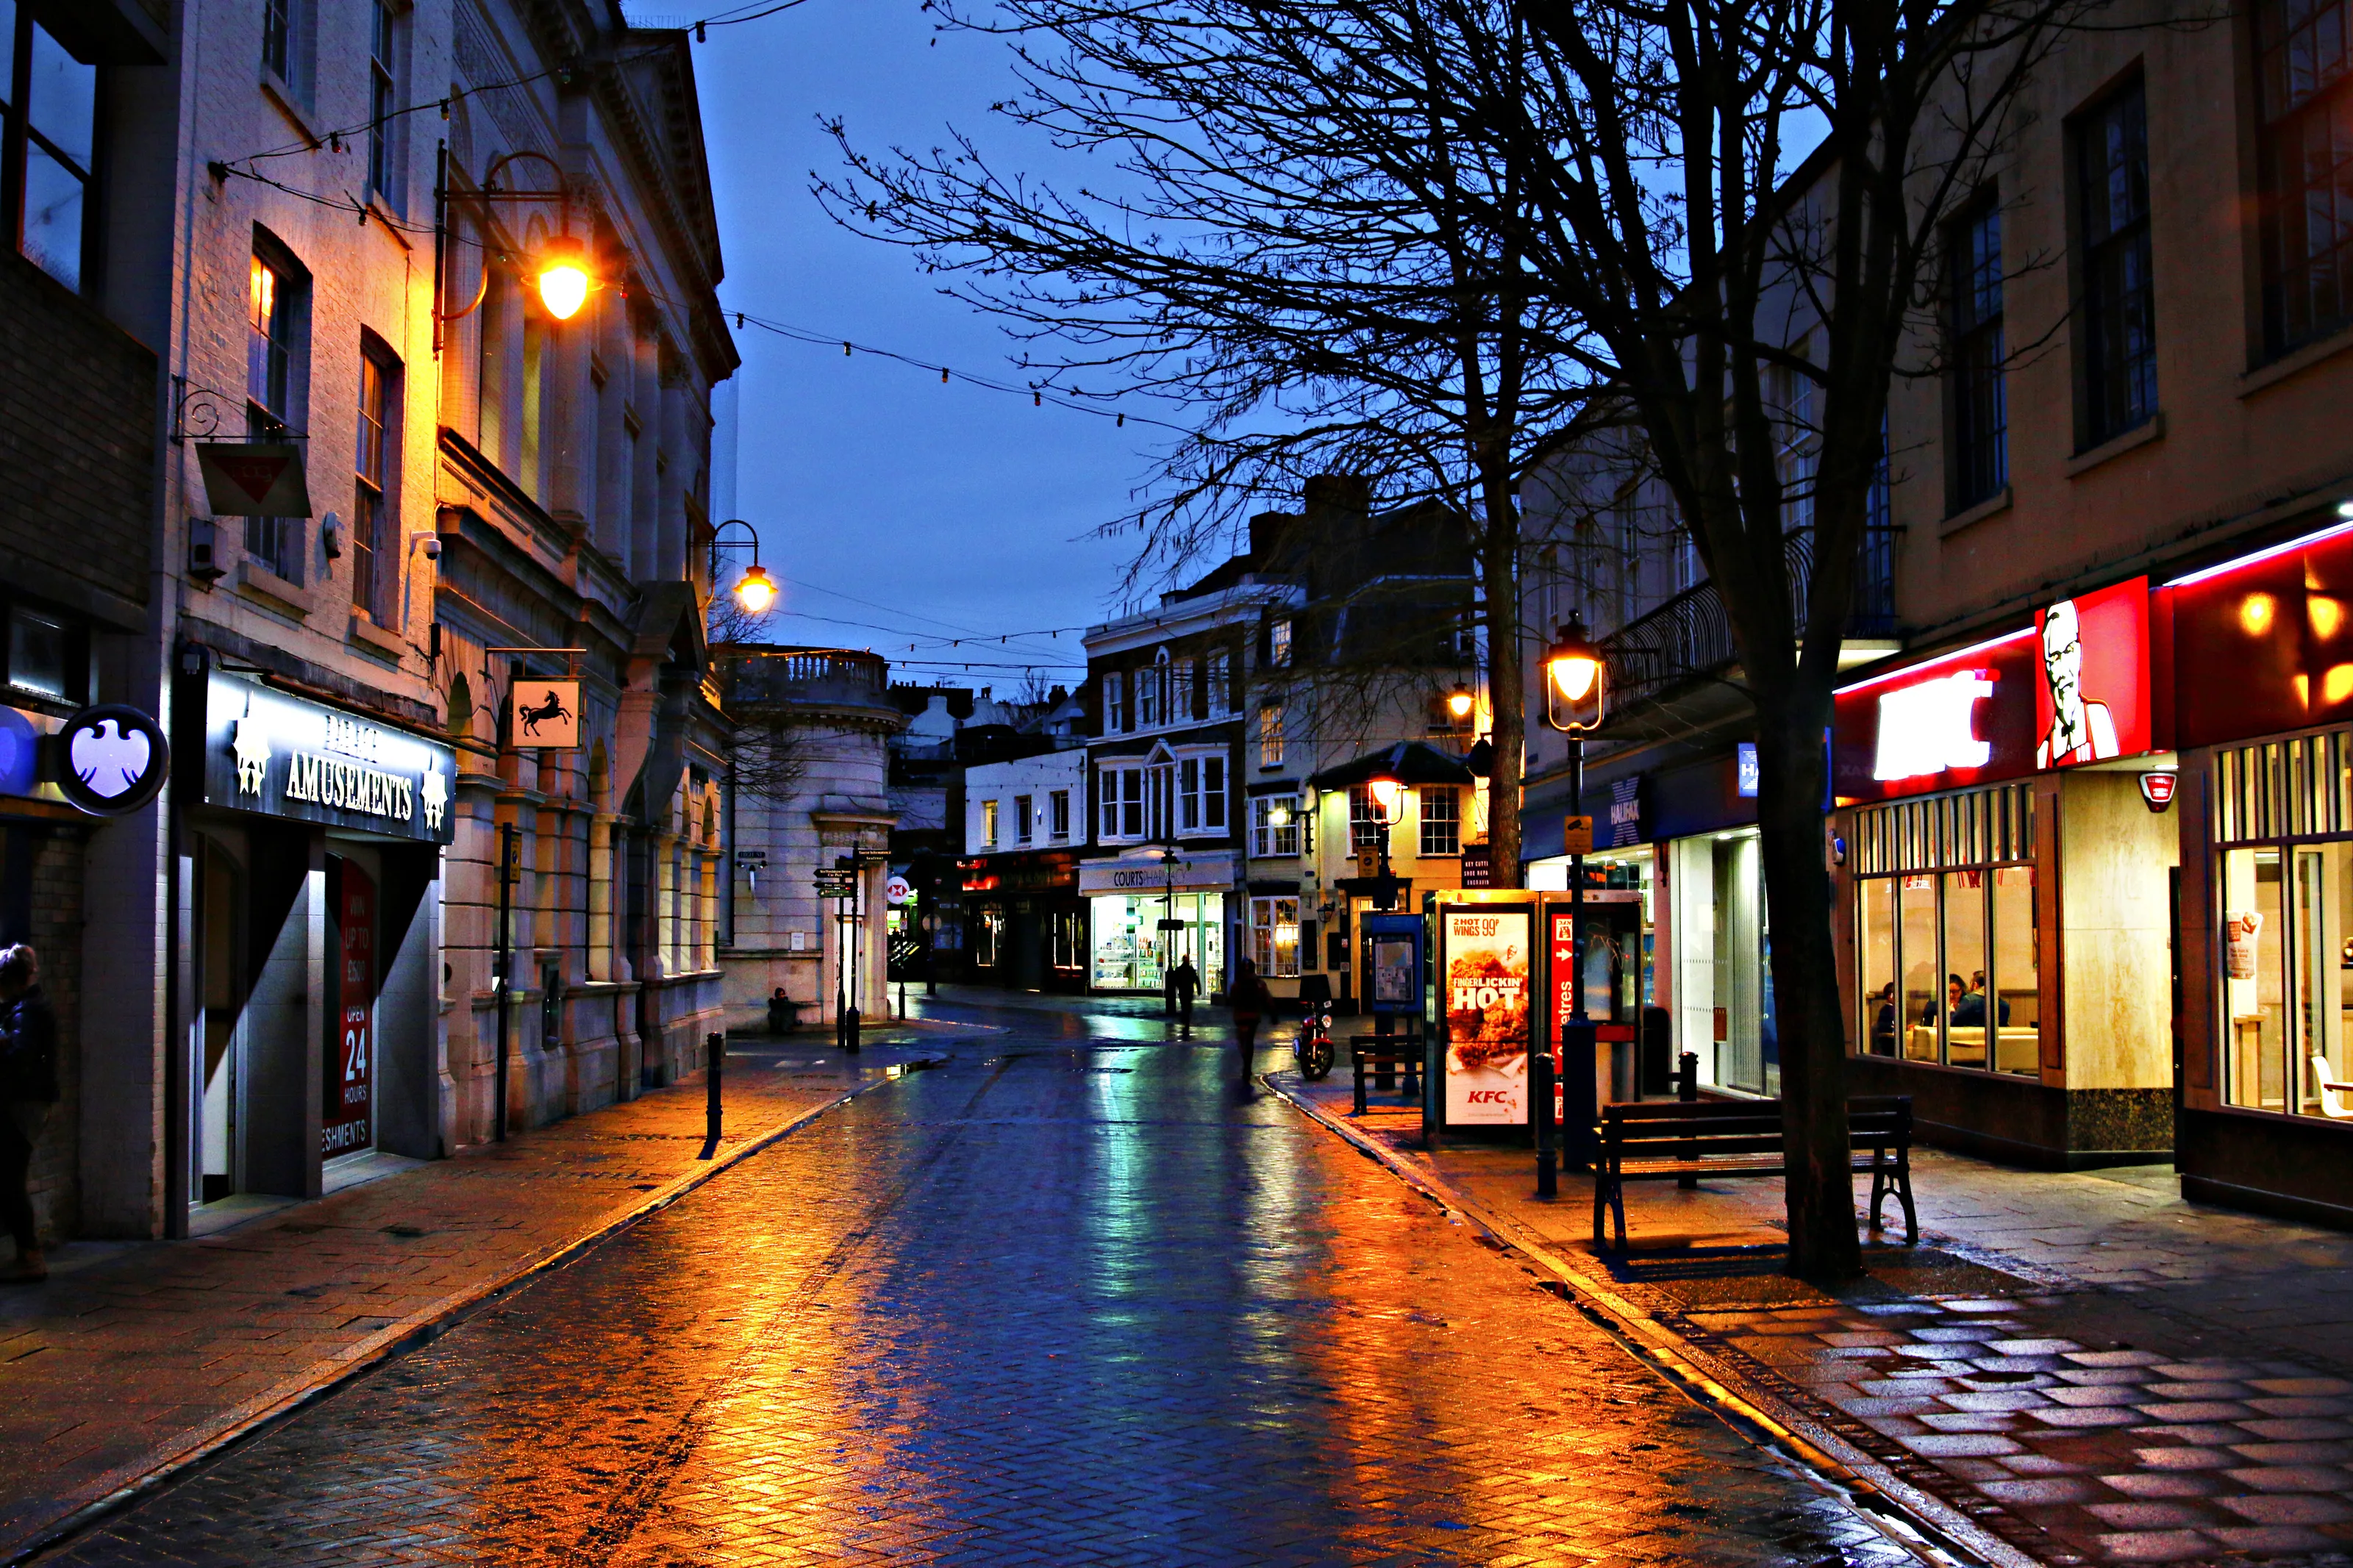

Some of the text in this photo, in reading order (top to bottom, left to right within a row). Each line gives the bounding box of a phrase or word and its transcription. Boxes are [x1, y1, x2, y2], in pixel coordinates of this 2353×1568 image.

[286, 749, 412, 820] AMUSEMENTS
[1611, 799, 1640, 825] HALIFAX
[350, 895, 365, 917] WIN
[345, 927, 369, 949] UP TO
[1454, 926, 1479, 936] WINGS
[348, 959, 365, 982] £500
[1454, 987, 1520, 1009] HOT
[347, 1006, 365, 1023] OPEN
[1558, 981, 1572, 1041] etres
[346, 1028, 366, 1081] 24
[345, 1084, 366, 1104] HOURS
[1468, 1091, 1507, 1103] KFC
